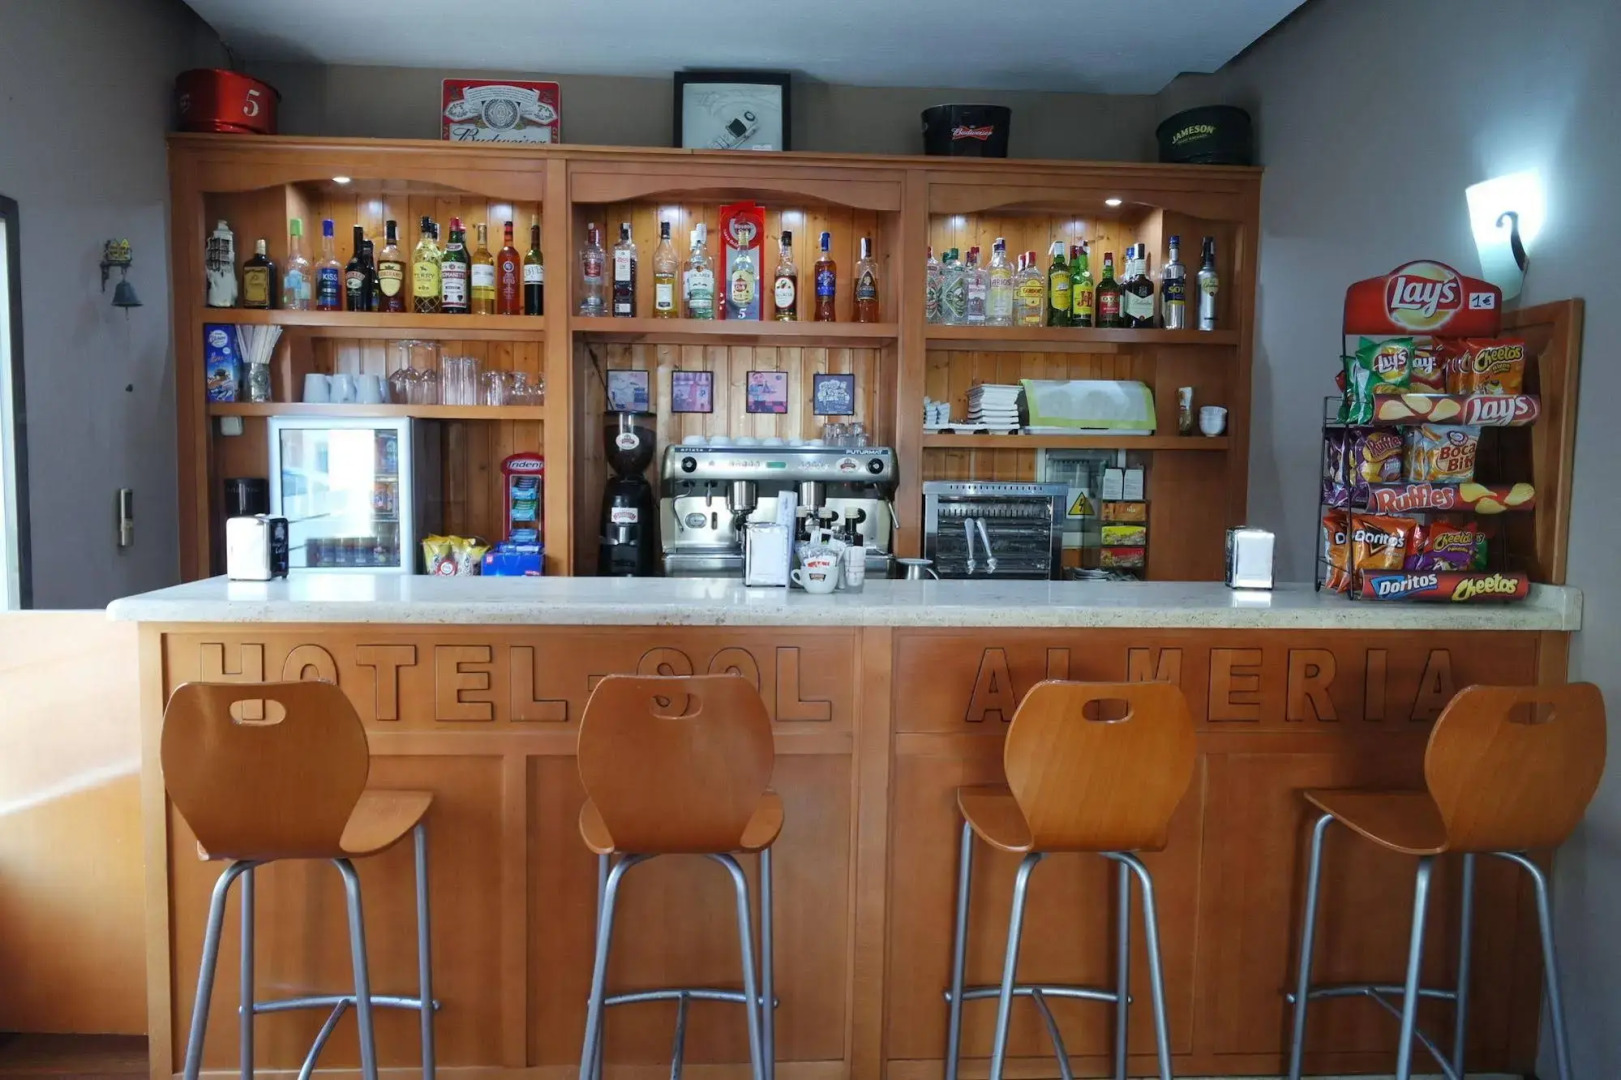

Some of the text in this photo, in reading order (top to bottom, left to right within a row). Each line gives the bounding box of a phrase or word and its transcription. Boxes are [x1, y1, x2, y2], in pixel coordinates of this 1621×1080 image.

[243, 89, 260, 117] 5
[1171, 124, 1217, 145] JAMESON
[322, 273, 338, 281] KISS
[1391, 277, 1457, 319] Lay's
[1471, 293, 1493, 309] 1€
[737, 308, 747, 319] 5
[1473, 345, 1522, 373] Cheetos
[1467, 396, 1530, 428] Lay's
[1440, 443, 1476, 461] Boca
[1376, 484, 1455, 513] Ruffles
[1355, 530, 1405, 548] Doritos
[1379, 572, 1438, 596] Doritos
[1452, 572, 1519, 601] Cheetos
